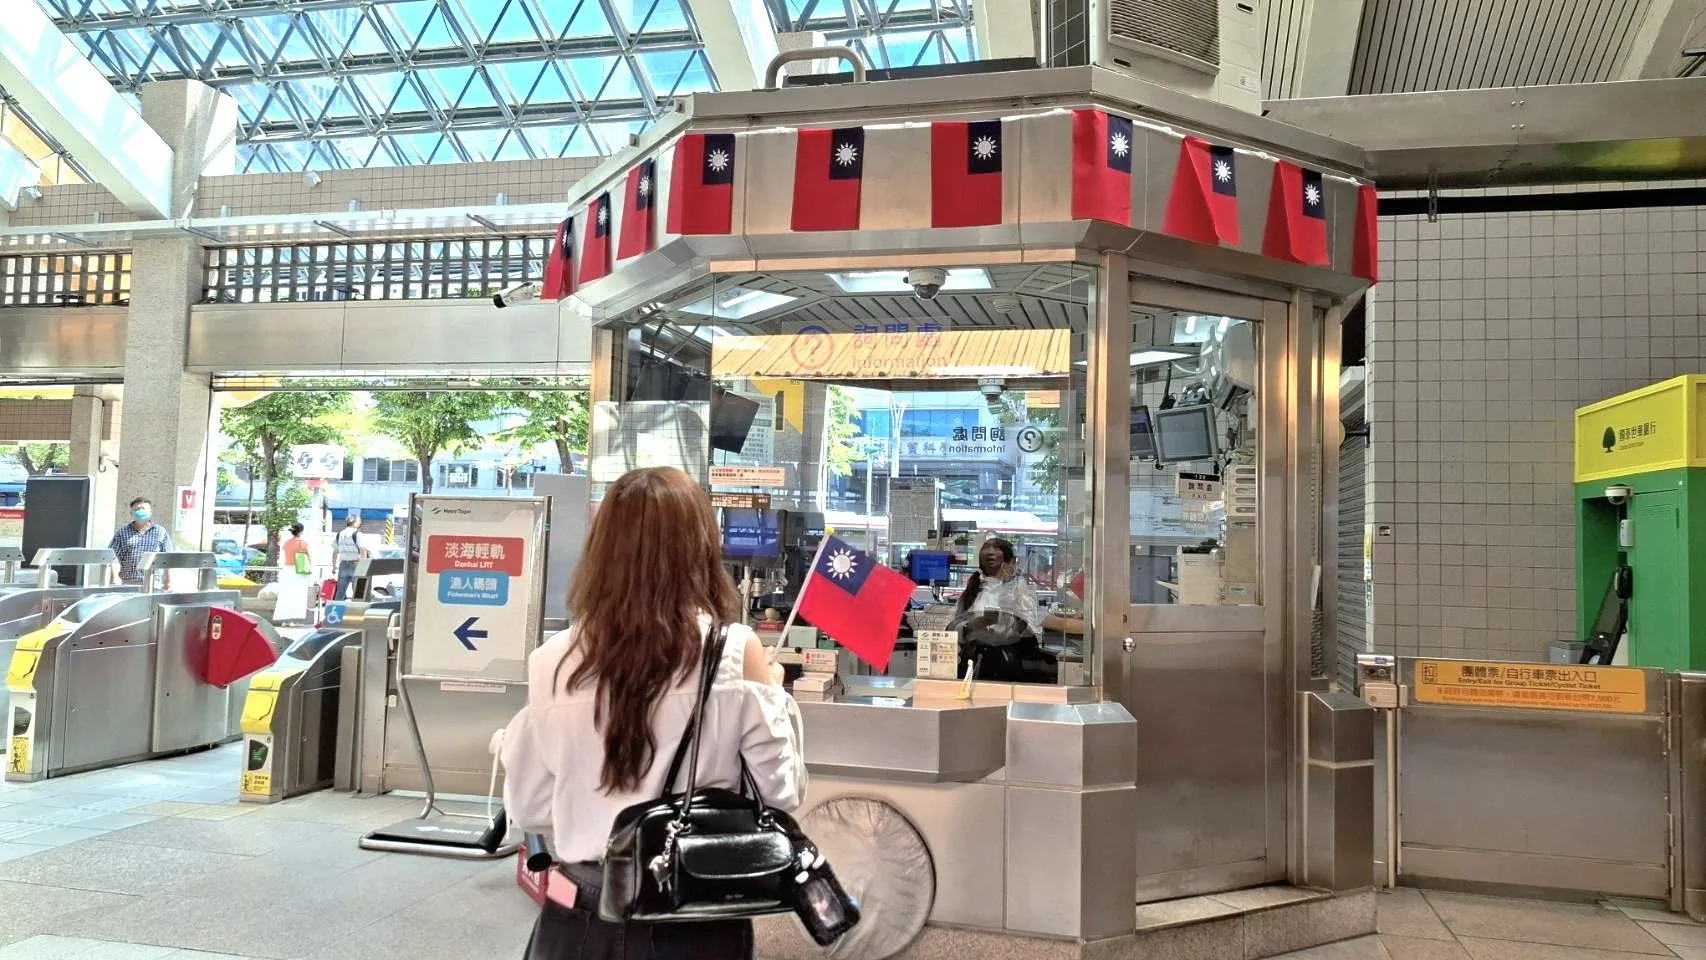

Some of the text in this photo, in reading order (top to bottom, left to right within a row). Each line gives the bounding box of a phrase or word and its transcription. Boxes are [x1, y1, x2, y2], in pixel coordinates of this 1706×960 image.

[854, 323, 942, 349] 詢問處
[853, 356, 946, 369] Information
[444, 542, 505, 560] 淡海輕軌
[454, 560, 494, 569] Danhai LRT
[449, 576, 498, 591] 漁人碼頭
[1423, 665, 1435, 677] 拉
[1462, 666, 1597, 682] 團體票/自行車票出入口
[1457, 677, 1492, 685] Entry/Exit
[1529, 681, 1577, 689] Ticket/Cyclist
